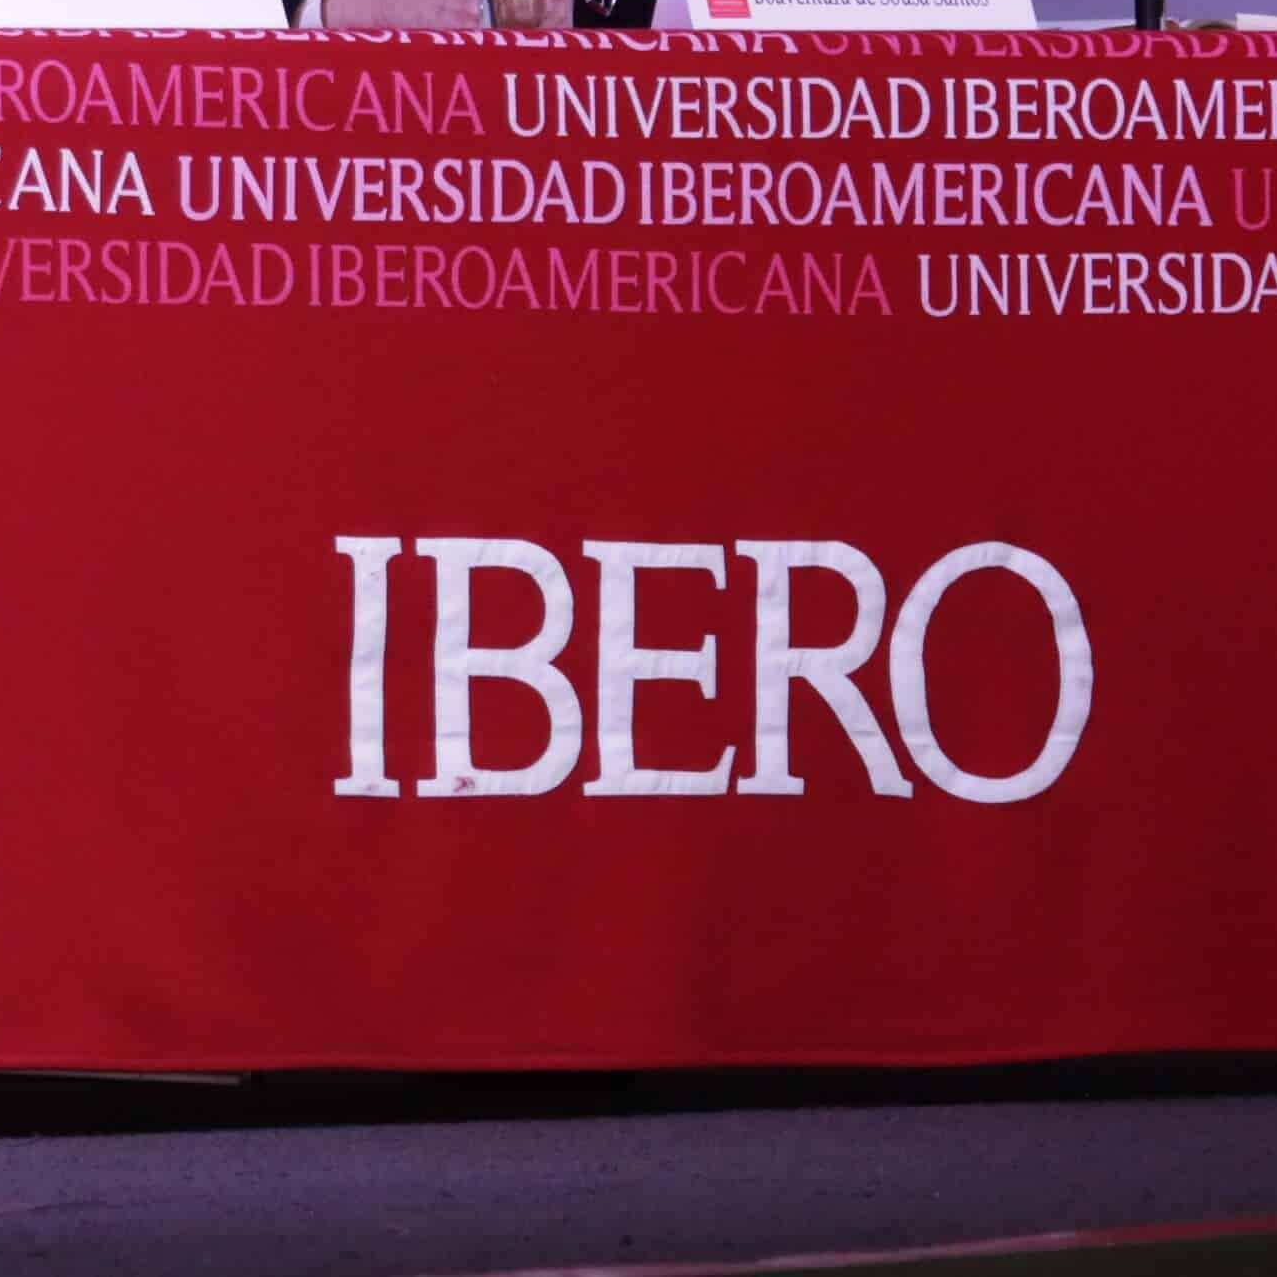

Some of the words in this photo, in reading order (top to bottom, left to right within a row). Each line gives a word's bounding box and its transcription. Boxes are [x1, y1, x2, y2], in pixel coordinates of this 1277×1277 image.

[504, 73, 931, 139] UNIVERSIDAD
[178, 155, 625, 223] UNIVERSIDAD
[639, 162, 1212, 226] IBEROAMERICANA
[309, 243, 891, 315] IBEROAMERICANA
[334, 535, 1094, 803] IBERO
